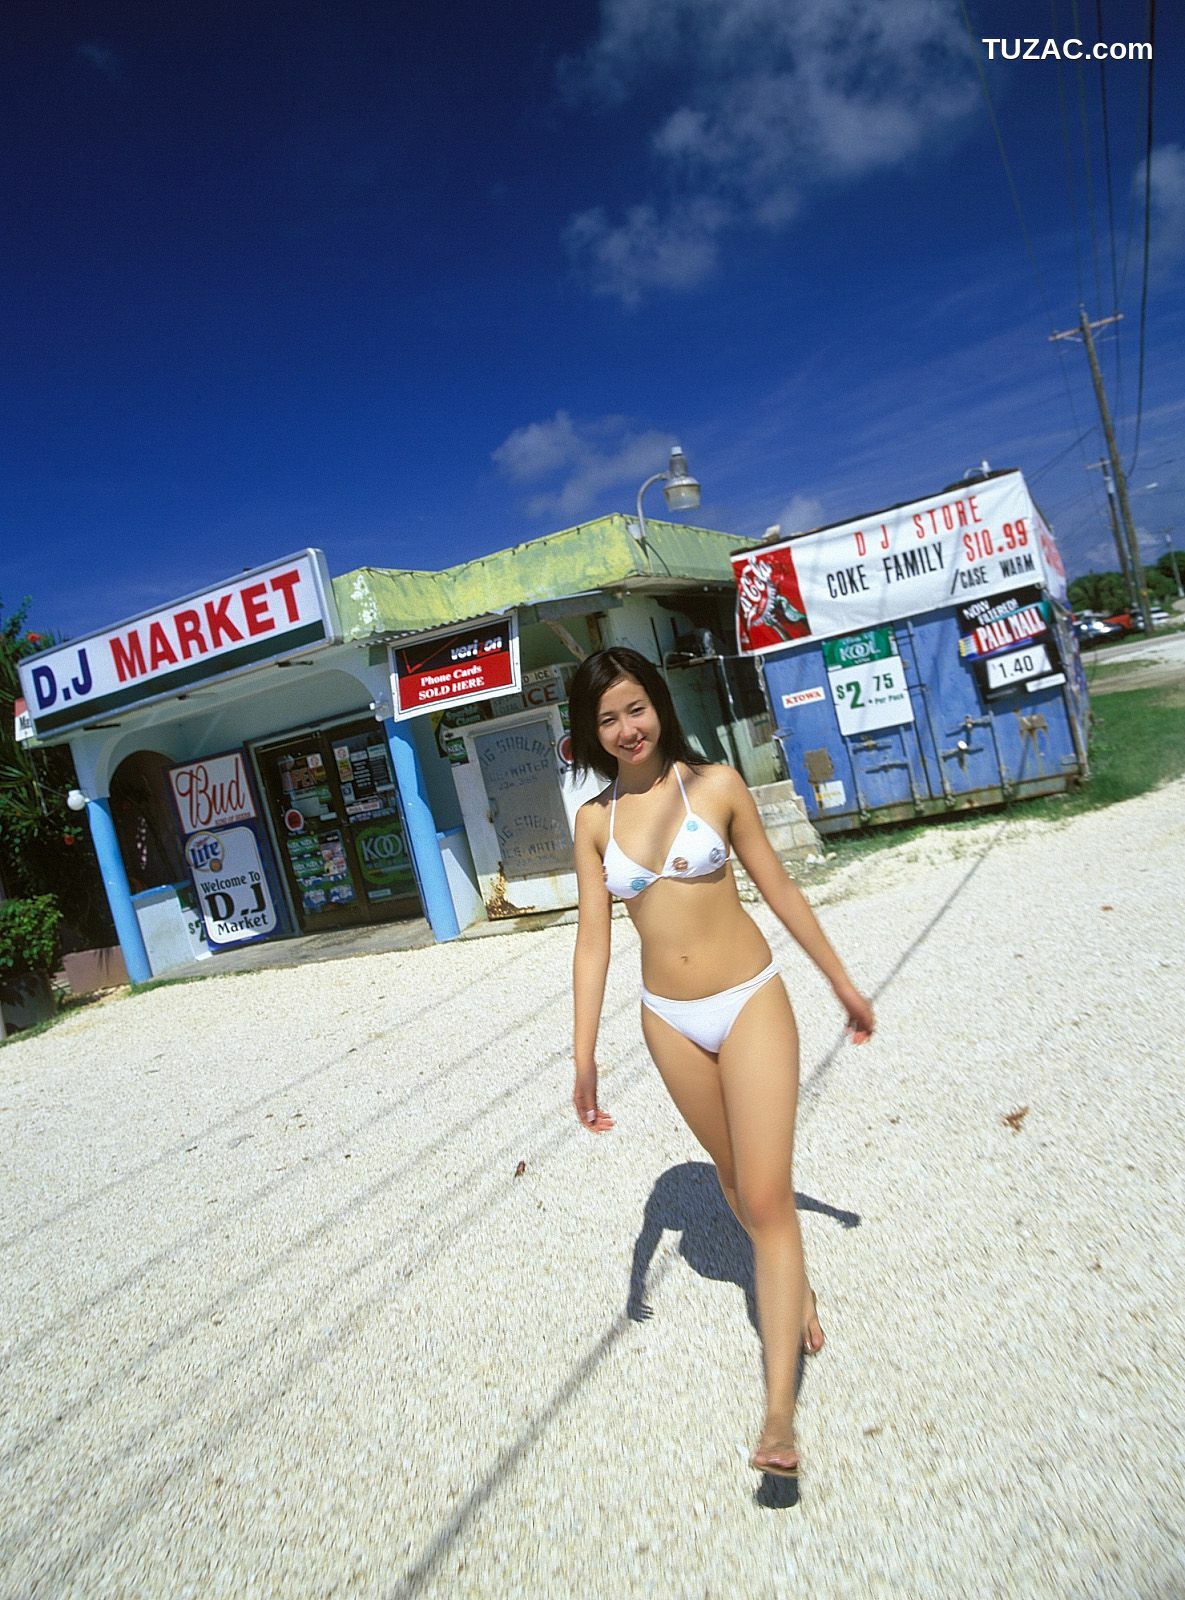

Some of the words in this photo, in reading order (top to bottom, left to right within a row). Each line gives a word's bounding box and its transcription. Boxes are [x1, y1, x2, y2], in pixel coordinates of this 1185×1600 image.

[912, 495, 983, 540] STORE
[826, 564, 870, 599] COKE
[883, 541, 946, 584] FAMILY
[1000, 553, 1036, 578] WARM
[962, 600, 990, 620] NOW
[31, 648, 94, 710] D.J
[109, 569, 301, 683] MARKET
[975, 618, 1014, 653] PALL
[1007, 607, 1048, 640] MALL
[451, 636, 503, 661] verizon
[839, 641, 880, 662] KOOL
[421, 673, 452, 687] Phone
[453, 664, 483, 679] Cards
[1000, 655, 1034, 679] 1.40
[418, 685, 451, 701] SOLD
[452, 676, 485, 694] HERE
[522, 684, 559, 708] ICE
[175, 756, 246, 828] Bud
[189, 841, 220, 870] Lite
[201, 875, 247, 895] Welcome
[249, 871, 261, 882] To
[205, 883, 267, 922] D.J
[217, 913, 269, 936] Market
